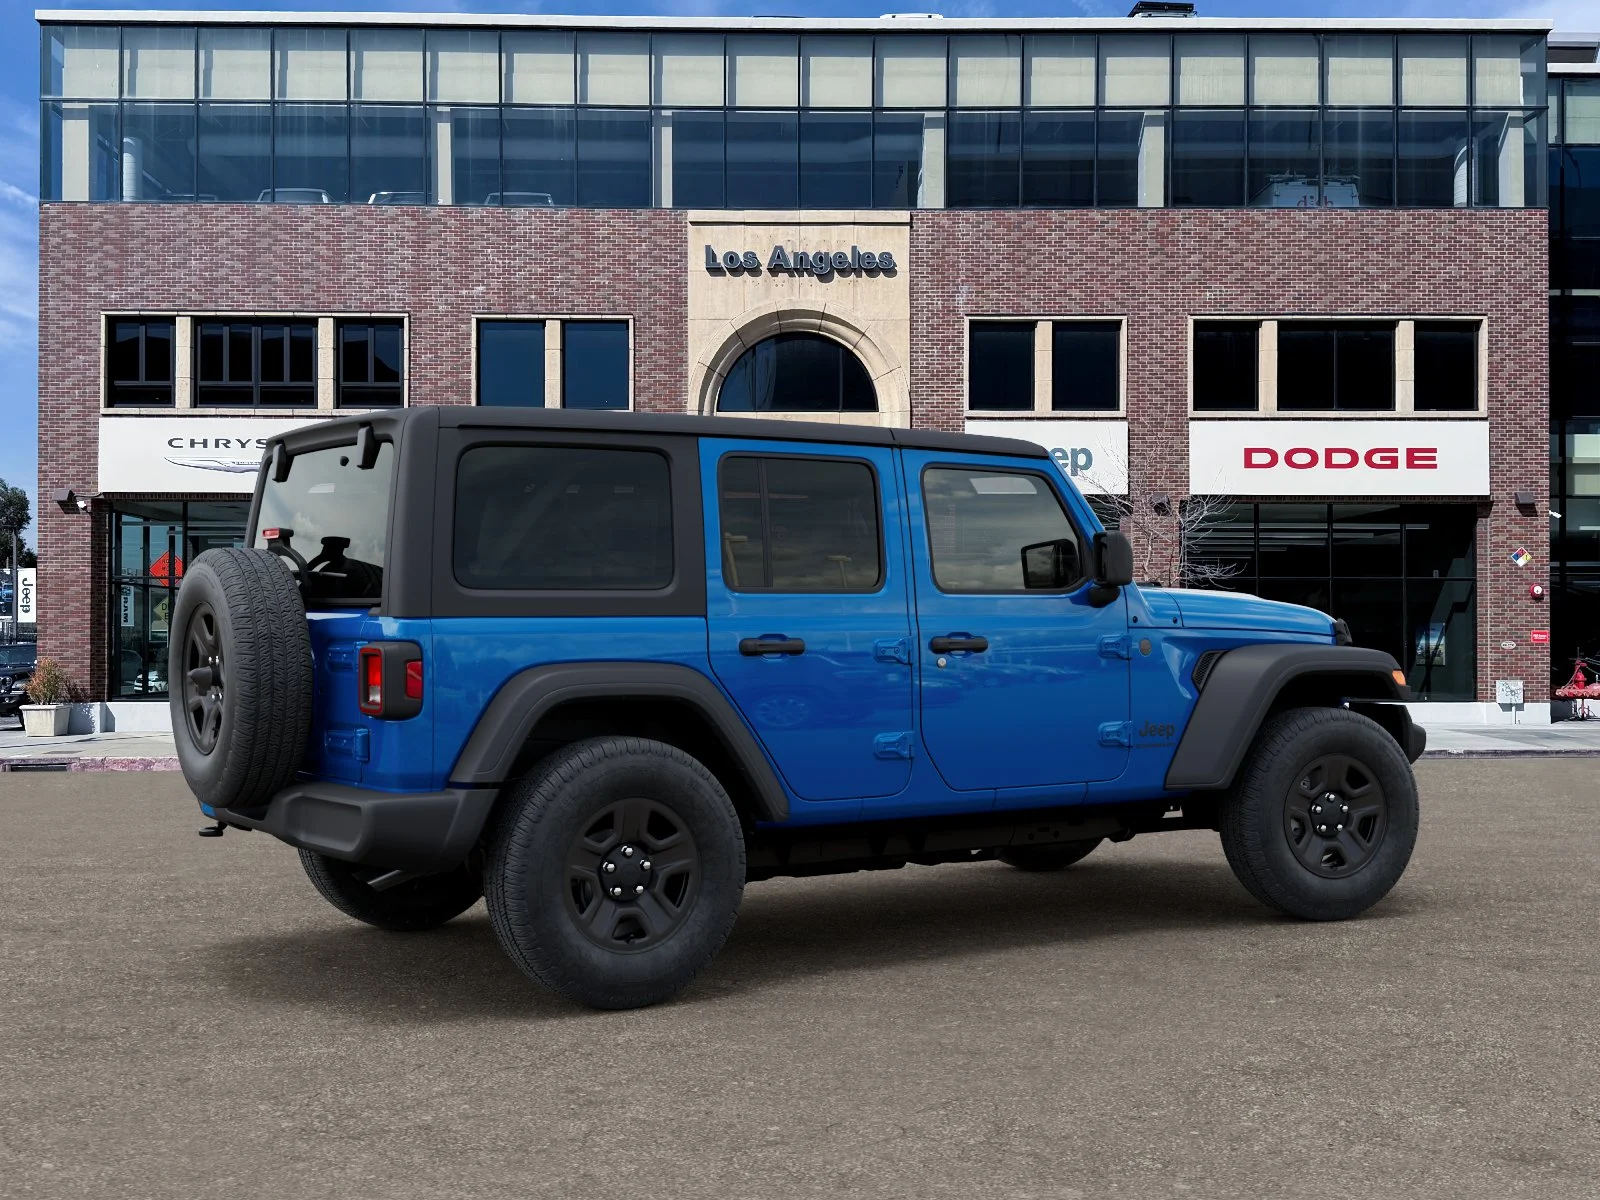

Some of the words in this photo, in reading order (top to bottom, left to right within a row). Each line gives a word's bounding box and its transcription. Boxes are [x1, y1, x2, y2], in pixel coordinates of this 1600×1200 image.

[704, 244, 758, 269] Los
[766, 245, 895, 275] Angeles
[1243, 447, 1438, 470] DODGE
[20, 577, 34, 614] Jeep
[1138, 719, 1175, 739] Jeep
